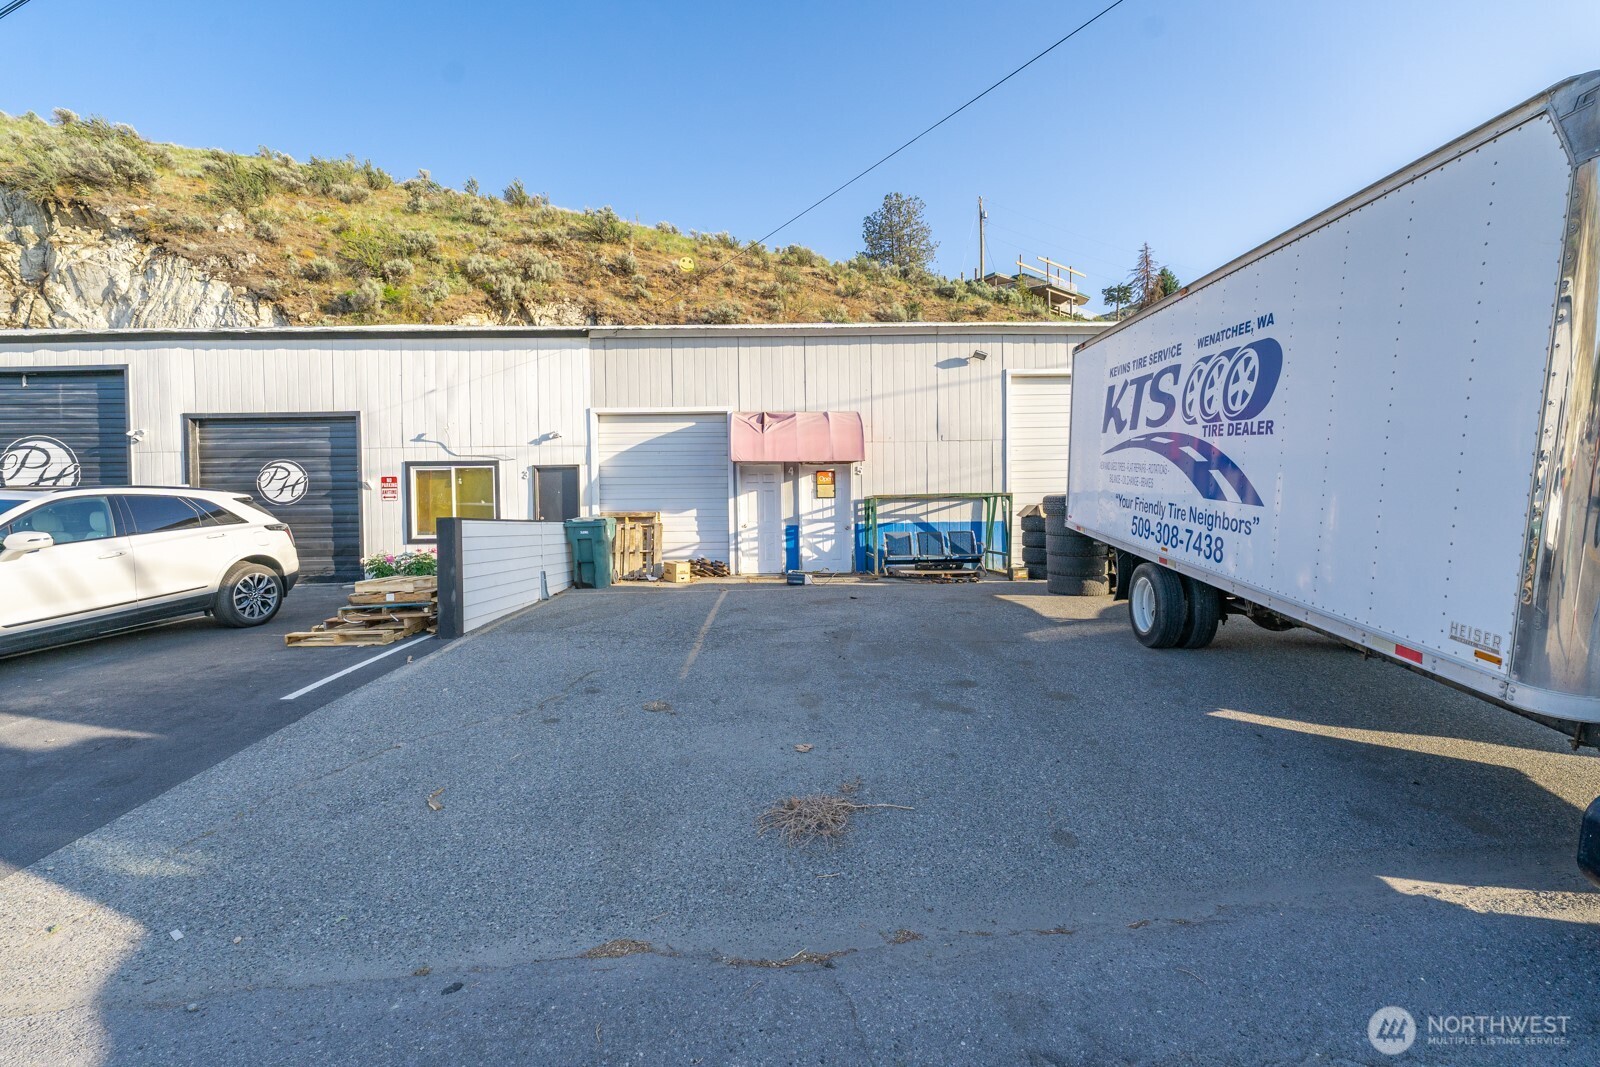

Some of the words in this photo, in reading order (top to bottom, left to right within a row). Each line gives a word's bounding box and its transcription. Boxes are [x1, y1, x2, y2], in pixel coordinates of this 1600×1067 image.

[1197, 320, 1254, 349] WENATCHEE,
[1257, 313, 1275, 329] WA
[1109, 363, 1131, 378] KEVINS
[1132, 357, 1147, 371] TIRE
[1149, 343, 1182, 363] SERVICE
[1102, 363, 1182, 435] KTS
[1202, 423, 1225, 437] TIRE
[1227, 420, 1274, 437] DEALER
[788, 467, 794, 476] 4
[1135, 497, 1166, 520] Friendly
[1168, 503, 1186, 521] Tire
[1131, 516, 1224, 563] 509-308-7438
[1450, 621, 1502, 648] HEISER
